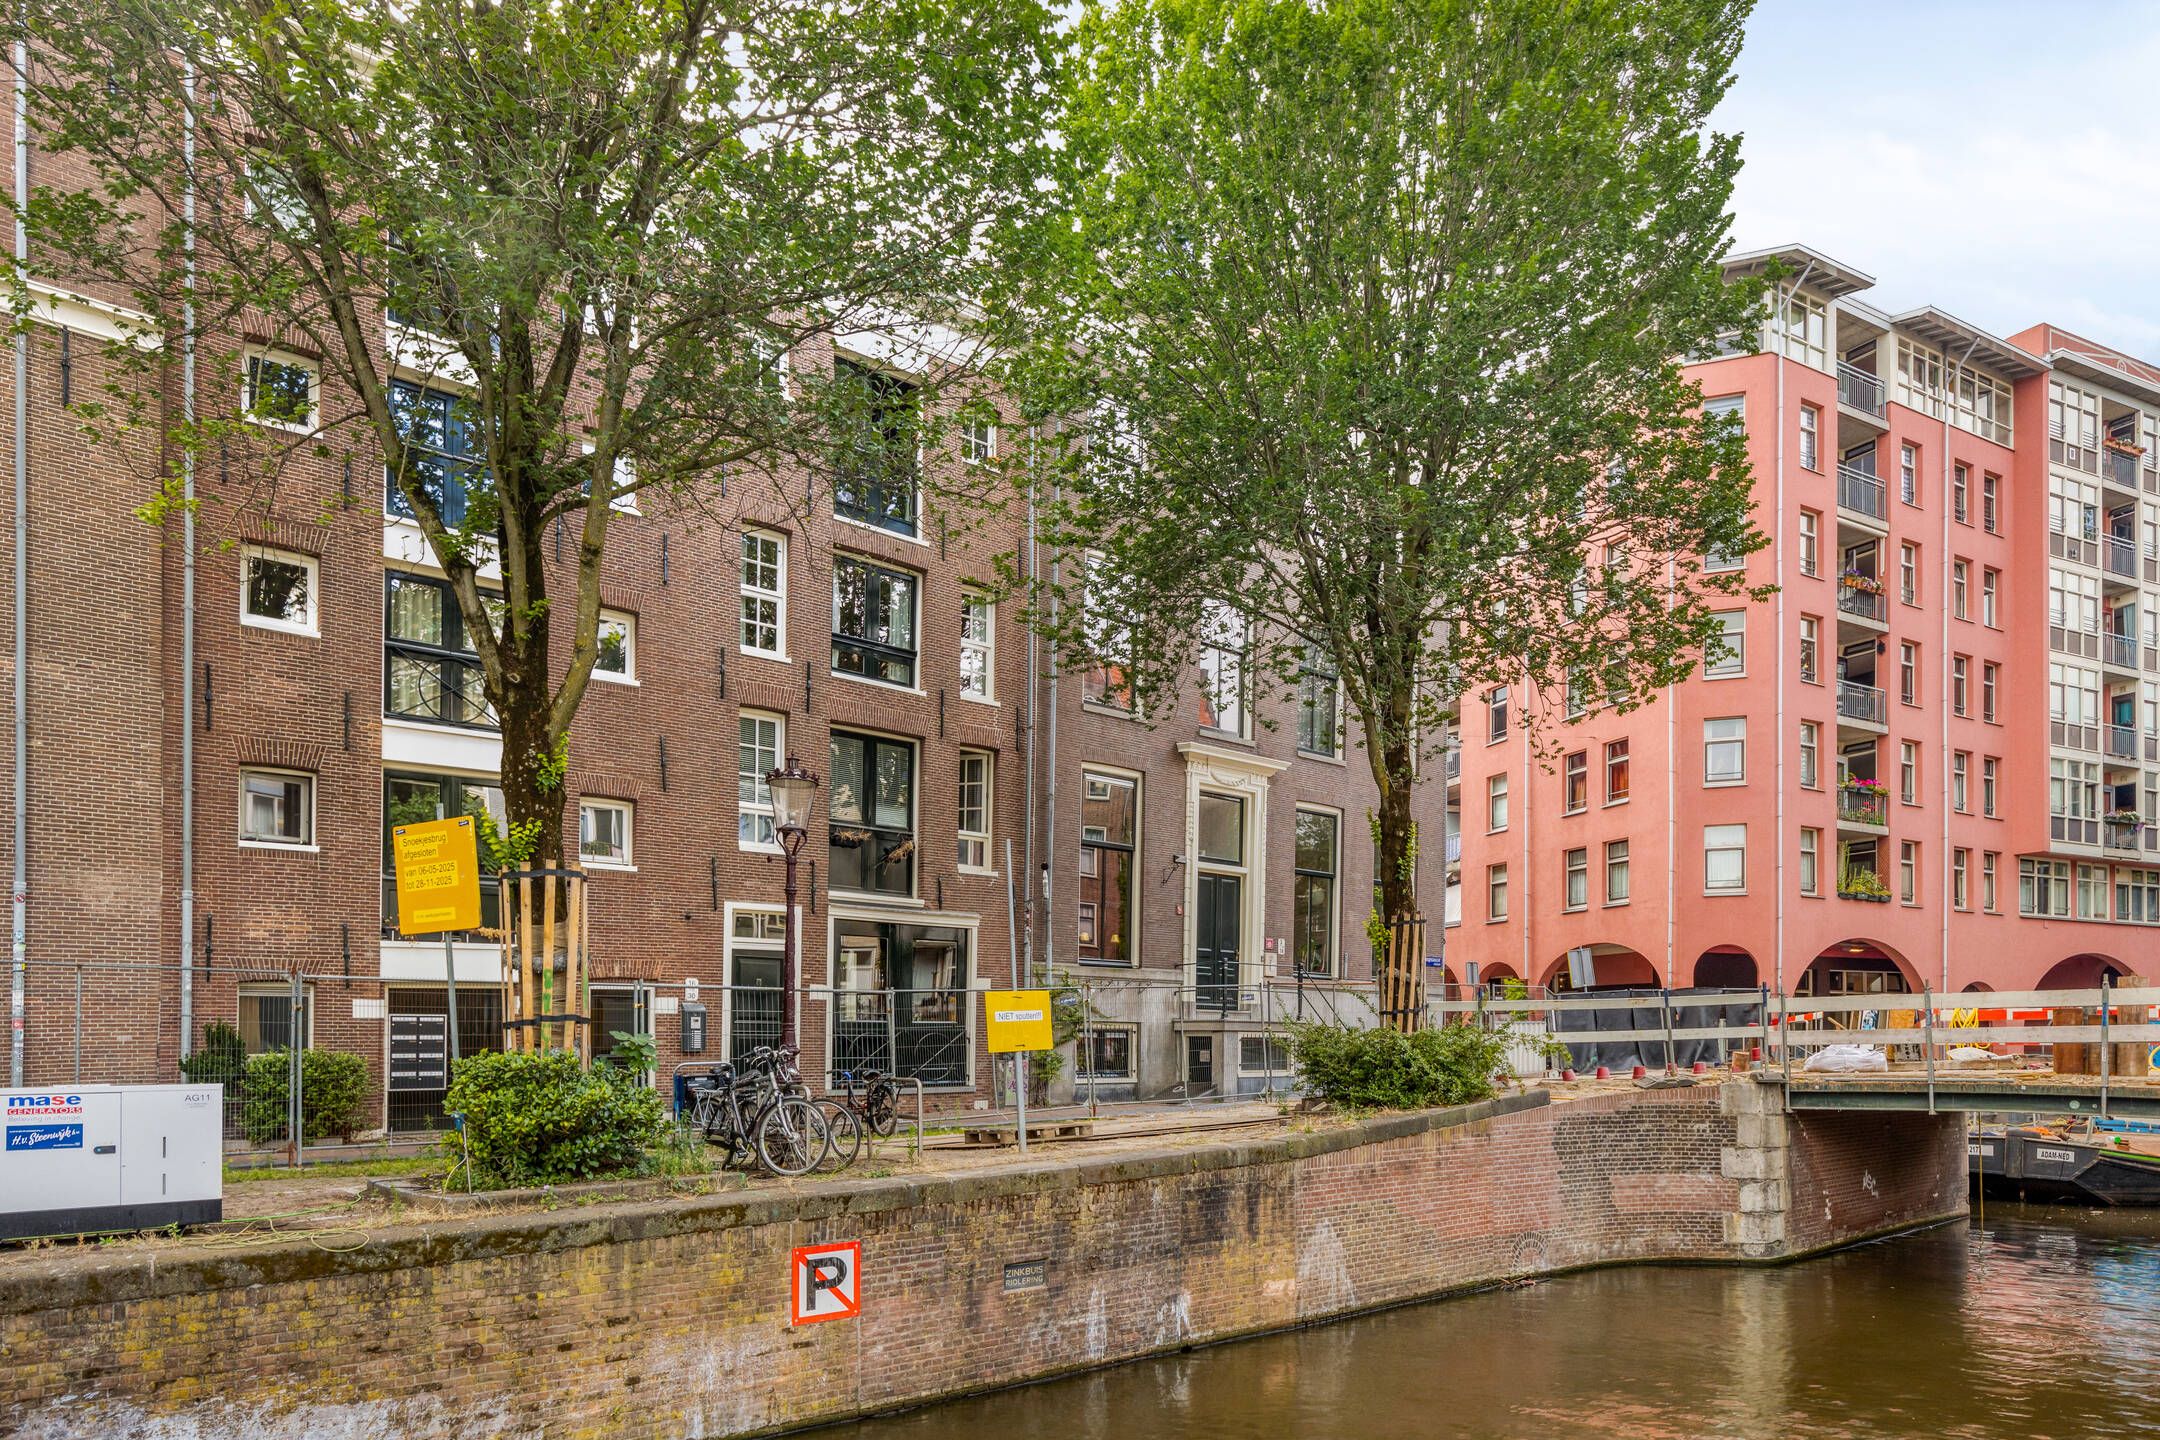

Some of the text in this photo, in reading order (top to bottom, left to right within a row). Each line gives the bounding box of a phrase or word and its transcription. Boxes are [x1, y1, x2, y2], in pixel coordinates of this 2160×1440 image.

[403, 834, 446, 847] Snoekjesbrug
[404, 848, 437, 860] afgesloten
[406, 862, 455, 877] van 06-05-2025
[406, 875, 453, 889] tot 28-11-2025
[998, 1012, 1014, 1020] NIET
[9, 1095, 81, 1107] mase
[8, 1107, 83, 1115] GENERATORS
[2041, 1151, 2070, 1161] ADAM-NED
[1005, 1265, 1043, 1278] ZINKBUIS
[806, 1256, 847, 1311] P
[1005, 1275, 1043, 1287] RIOLERING
